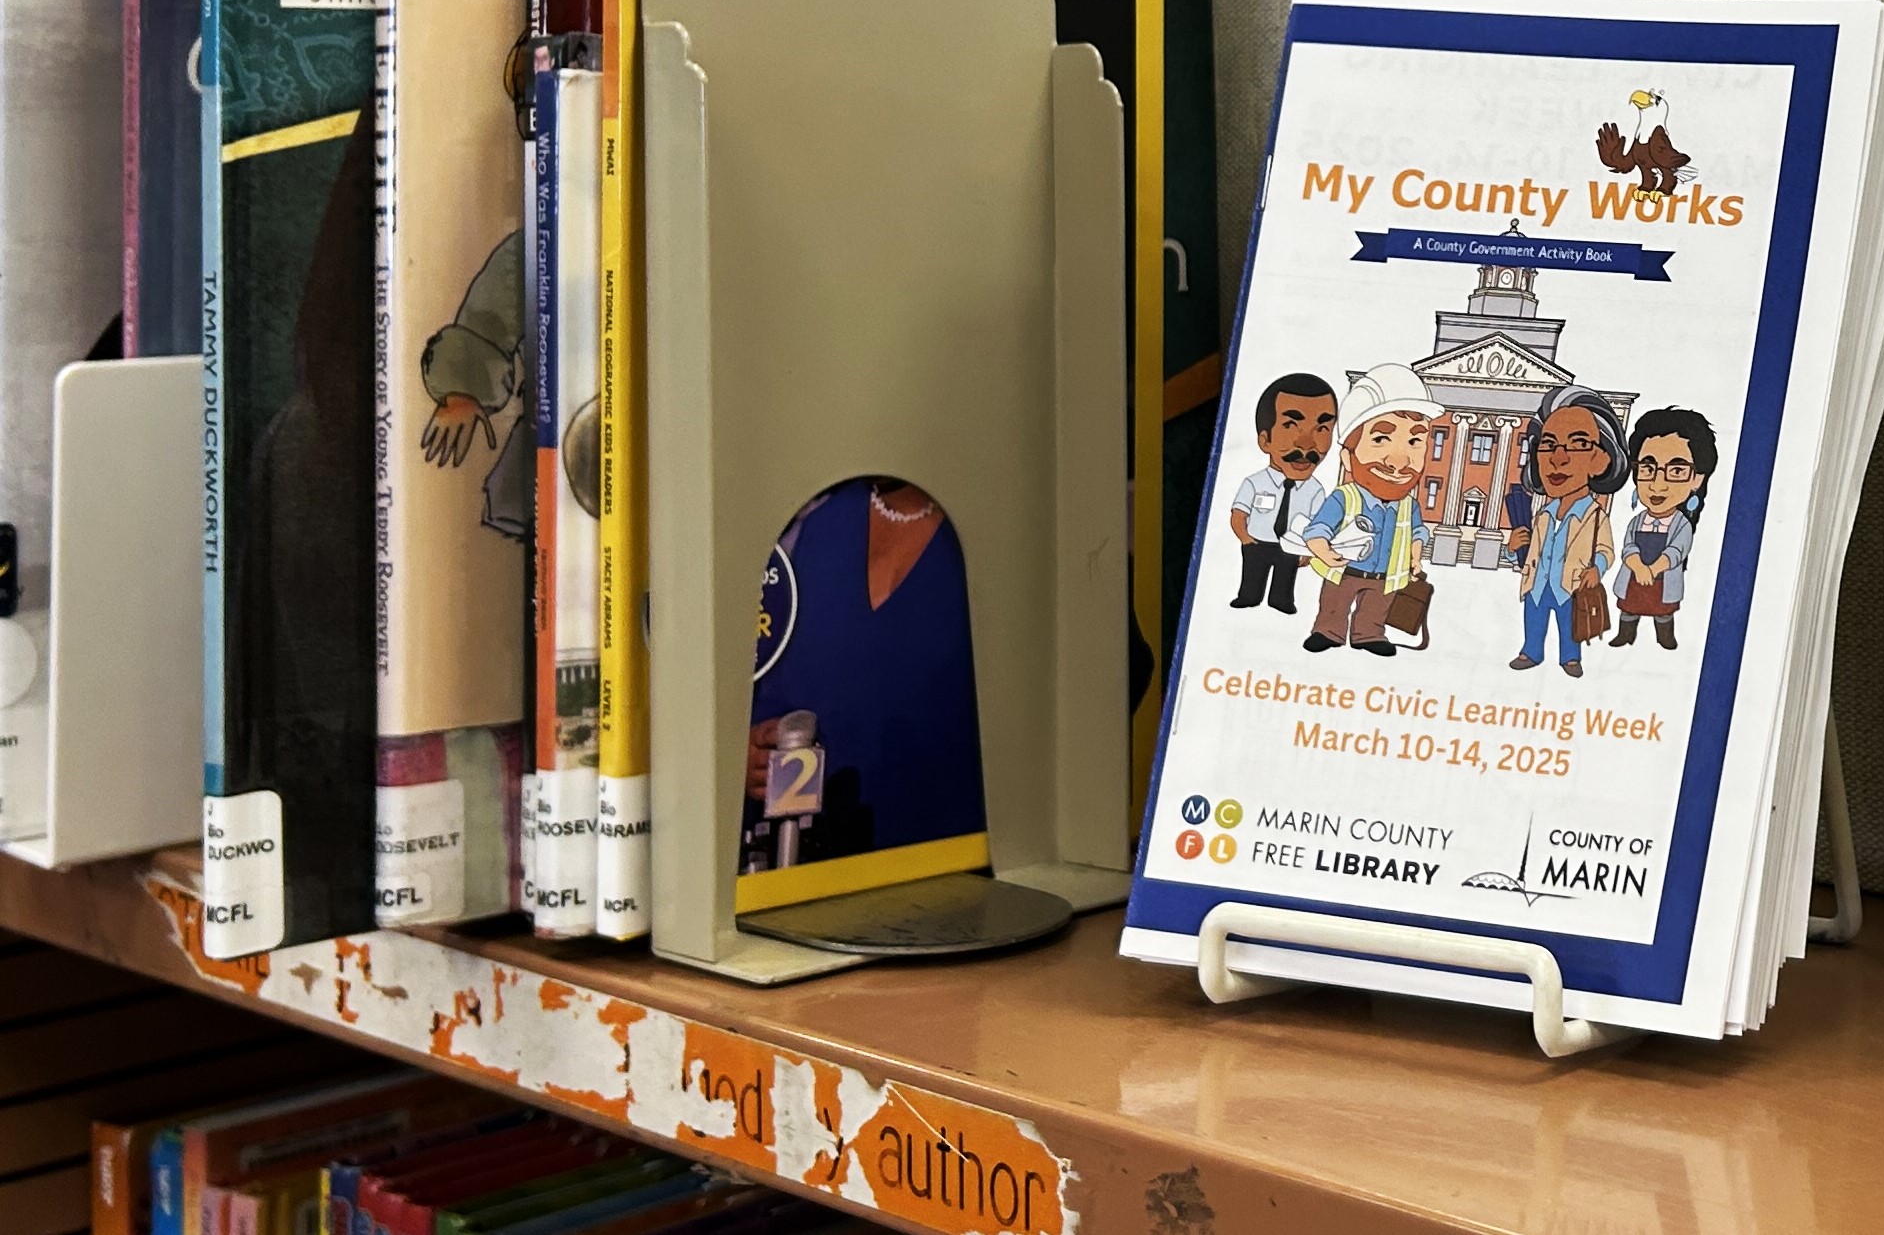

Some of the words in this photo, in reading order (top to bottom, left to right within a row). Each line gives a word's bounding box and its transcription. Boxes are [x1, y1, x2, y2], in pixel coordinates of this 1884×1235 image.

[538, 132, 551, 175] Who
[538, 182, 551, 224] Was
[1302, 163, 1374, 214] My
[1392, 169, 1569, 227] County
[1589, 181, 1744, 226] Works
[538, 229, 551, 307] Franklin
[1414, 238, 1423, 250] A
[1425, 238, 1466, 256] County
[1470, 241, 1534, 259] Government
[1539, 246, 1583, 263] Activity
[1586, 248, 1614, 263] Book
[203, 270, 218, 378] TAMMY
[537, 314, 551, 424] Roosevelt?
[203, 386, 220, 574] DUCKWORTH
[1203, 667, 1354, 709] Celebrate
[1365, 686, 1438, 720] Civic
[1446, 695, 1576, 742] Learning
[1585, 708, 1663, 742] Week
[1294, 721, 1388, 758] March
[1396, 732, 1488, 775] 10-14,
[1497, 743, 1571, 777] 2025
[1257, 807, 1341, 837] MARIN
[1350, 818, 1453, 851] COUNTY
[1549, 829, 1624, 854] COUNTY
[1629, 838, 1654, 856] OF
[1253, 841, 1304, 870] FREE
[1315, 849, 1440, 886] LIBRARY
[1541, 856, 1647, 897] MARIN
[878, 1125, 1047, 1232] author
